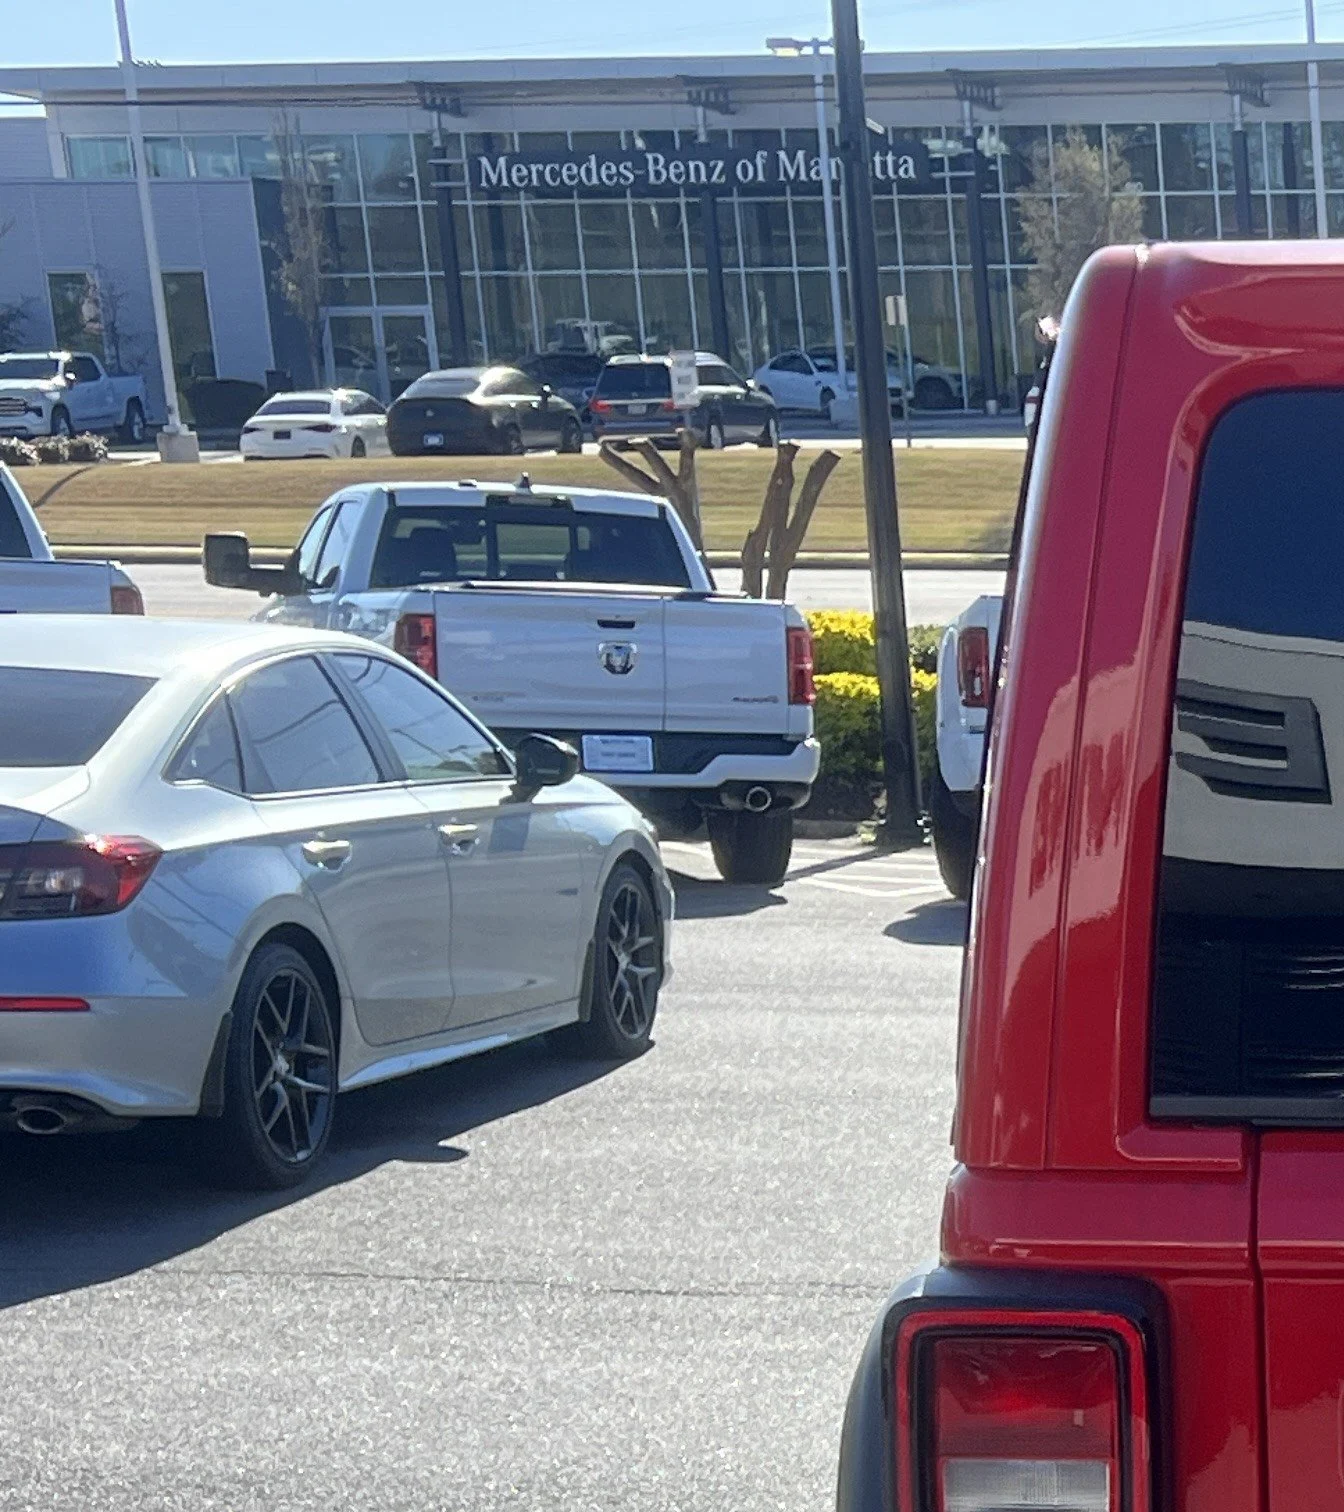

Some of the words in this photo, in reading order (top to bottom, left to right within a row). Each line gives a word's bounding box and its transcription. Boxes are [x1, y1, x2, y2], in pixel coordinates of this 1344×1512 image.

[478, 151, 727, 187] Mercedes-Benz
[735, 150, 768, 183] of
[776, 149, 917, 183] Martta
